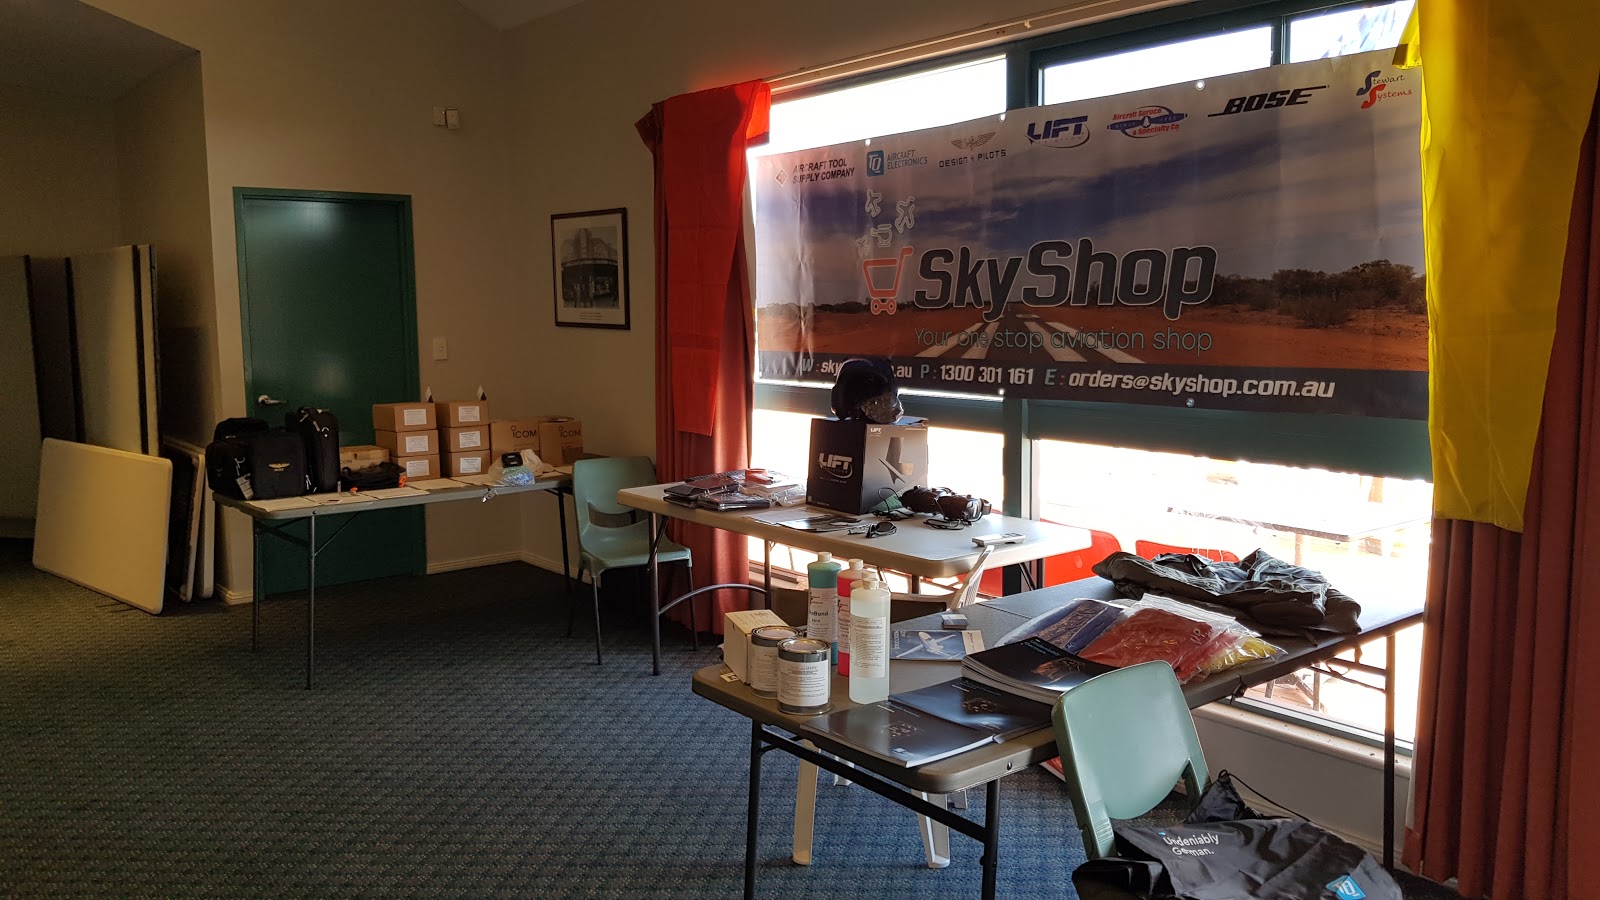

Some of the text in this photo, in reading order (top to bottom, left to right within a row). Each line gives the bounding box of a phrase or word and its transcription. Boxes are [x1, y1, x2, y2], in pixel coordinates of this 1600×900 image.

[1356, 70, 1405, 96] Stewart
[1212, 86, 1322, 117] BOSE
[1361, 84, 1413, 109] Systems
[1112, 107, 1162, 121] Aircraft Spruce
[1027, 115, 1088, 140] LIFT
[1138, 124, 1170, 135] Specialty
[868, 154, 882, 174] TQ
[886, 150, 917, 162] AIRCRAFT
[886, 156, 928, 170] ELECTRONICS
[939, 156, 969, 168] DESIGN
[977, 149, 1007, 161] PILOTS
[793, 158, 848, 174] AIRCRAFT TOOL
[793, 172, 820, 184] SUPPLY
[820, 167, 855, 181] COMPANY
[914, 238, 1218, 323] SkyShop
[914, 326, 1213, 357] Your one stop aviation shop
[940, 365, 975, 381] 1300
[978, 366, 1003, 383] 301
[1007, 367, 1034, 385] 161
[1068, 371, 1336, 399] orders@skyshop.com.au
[818, 452, 853, 471] LIFT
